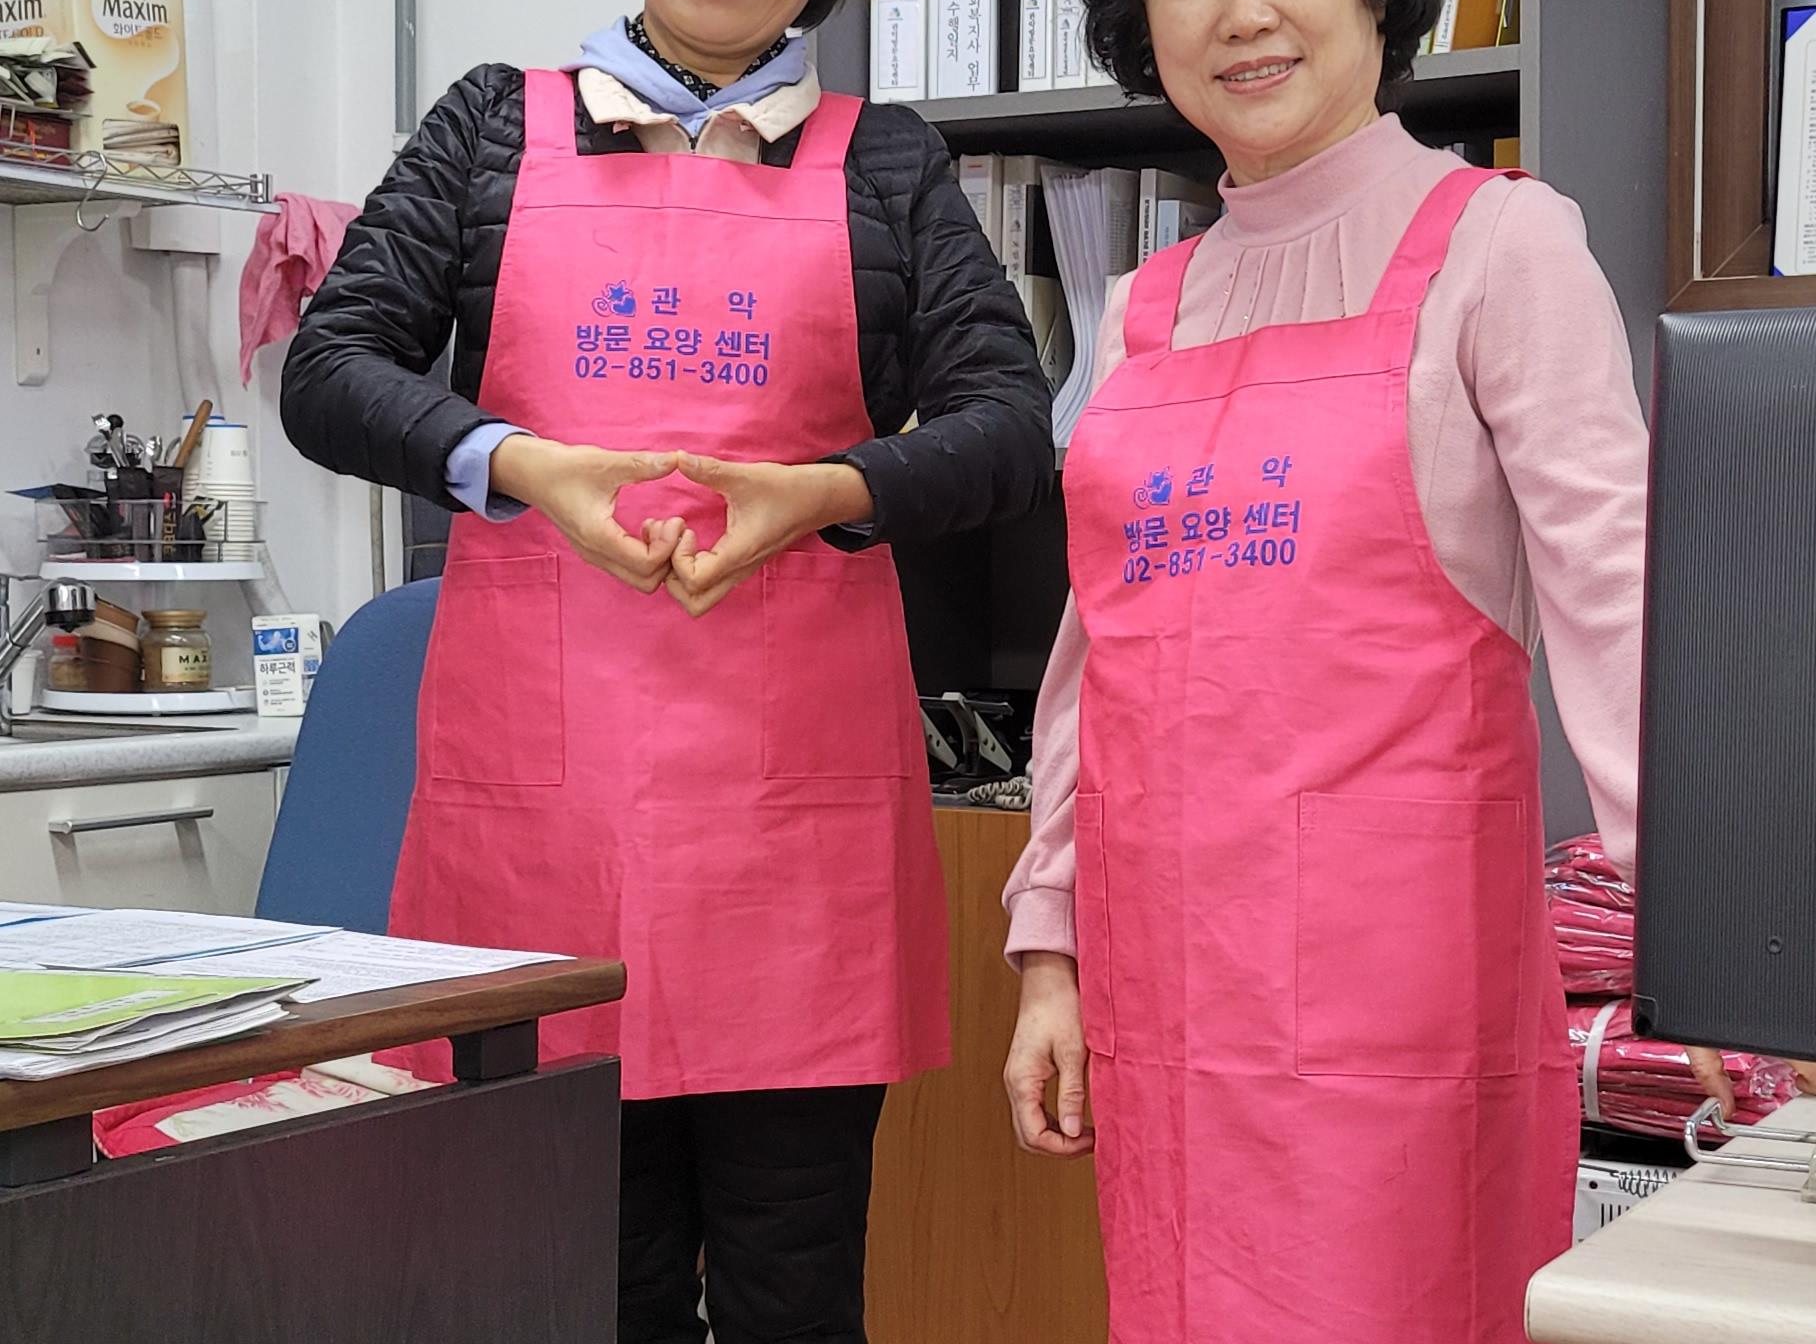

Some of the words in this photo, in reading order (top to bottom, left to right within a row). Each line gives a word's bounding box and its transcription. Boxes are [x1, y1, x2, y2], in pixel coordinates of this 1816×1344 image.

[576, 324, 631, 352] 방문
[643, 327, 702, 356] 요양
[714, 330, 770, 360] 센터
[574, 355, 768, 386] 02-851-3400
[1123, 515, 1169, 553] 방문
[1181, 506, 1231, 541] 요양
[1242, 499, 1300, 535] 센터
[1122, 537, 1297, 584] 02-851-3400
